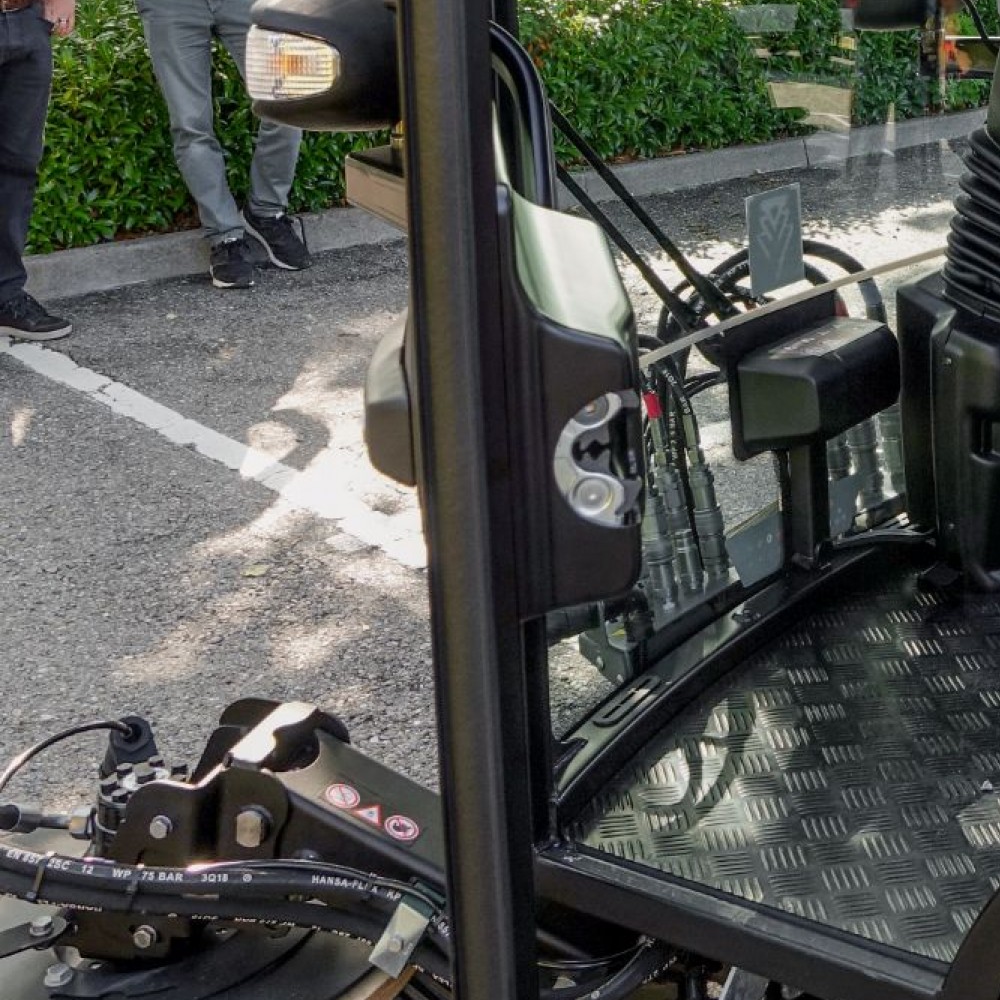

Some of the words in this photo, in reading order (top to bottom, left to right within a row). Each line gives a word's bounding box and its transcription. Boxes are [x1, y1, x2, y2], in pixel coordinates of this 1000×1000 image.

[82, 864, 94, 875] 12
[112, 868, 131, 878] WP
[158, 872, 183, 882] BAR
